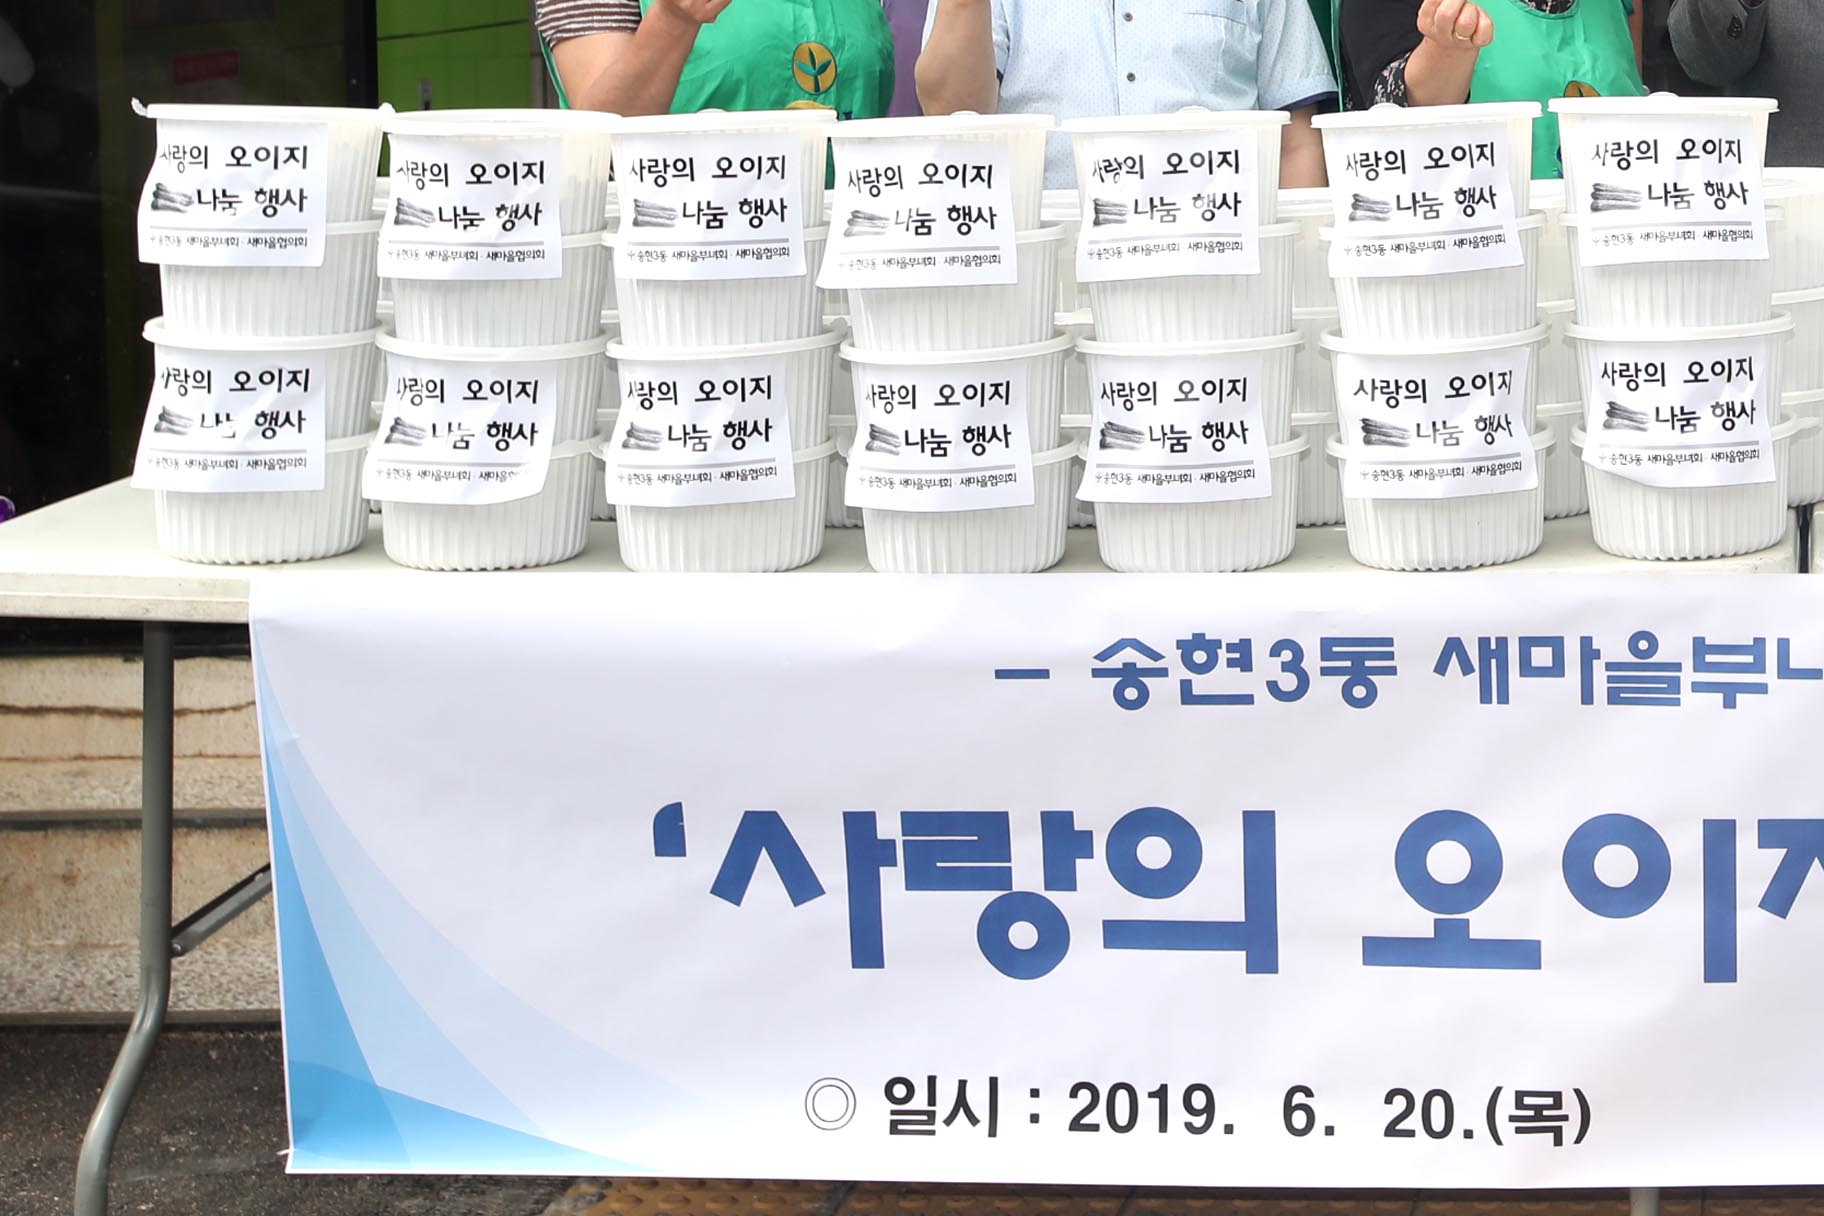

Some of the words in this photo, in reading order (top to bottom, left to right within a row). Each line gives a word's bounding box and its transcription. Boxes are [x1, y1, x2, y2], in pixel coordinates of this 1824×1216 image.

[161, 146, 208, 173] 사랑의
[226, 146, 307, 170] 오이지
[1093, 155, 1144, 183] 사랑의
[1163, 150, 1239, 175] 오이지
[1347, 150, 1406, 181] 사랑의
[1424, 142, 1494, 169] 오이지
[1595, 139, 1658, 170] 사랑의
[1676, 139, 1741, 164] 오이지
[632, 157, 694, 187] 사랑의
[712, 155, 785, 180] 오이지
[197, 188, 243, 215] 나눔
[255, 188, 307, 218] 행사
[1134, 197, 1180, 223] 나눔
[1192, 192, 1241, 221] 행사
[1396, 192, 1443, 220] 나눔
[1454, 185, 1496, 217] 행사
[1648, 182, 1694, 209] 나눔
[1704, 180, 1748, 210] 행사
[683, 201, 728, 229] 나눔
[739, 198, 787, 229] 행사
[1090, 633, 1399, 712] 송현3동
[653, 801, 1279, 981] '사랑의
[883, 1074, 1000, 1138] 일시
[1067, 1081, 1236, 1136] 2019.
[1281, 1084, 1337, 1138] 6.
[1382, 1086, 1593, 1148] 20.(목)
